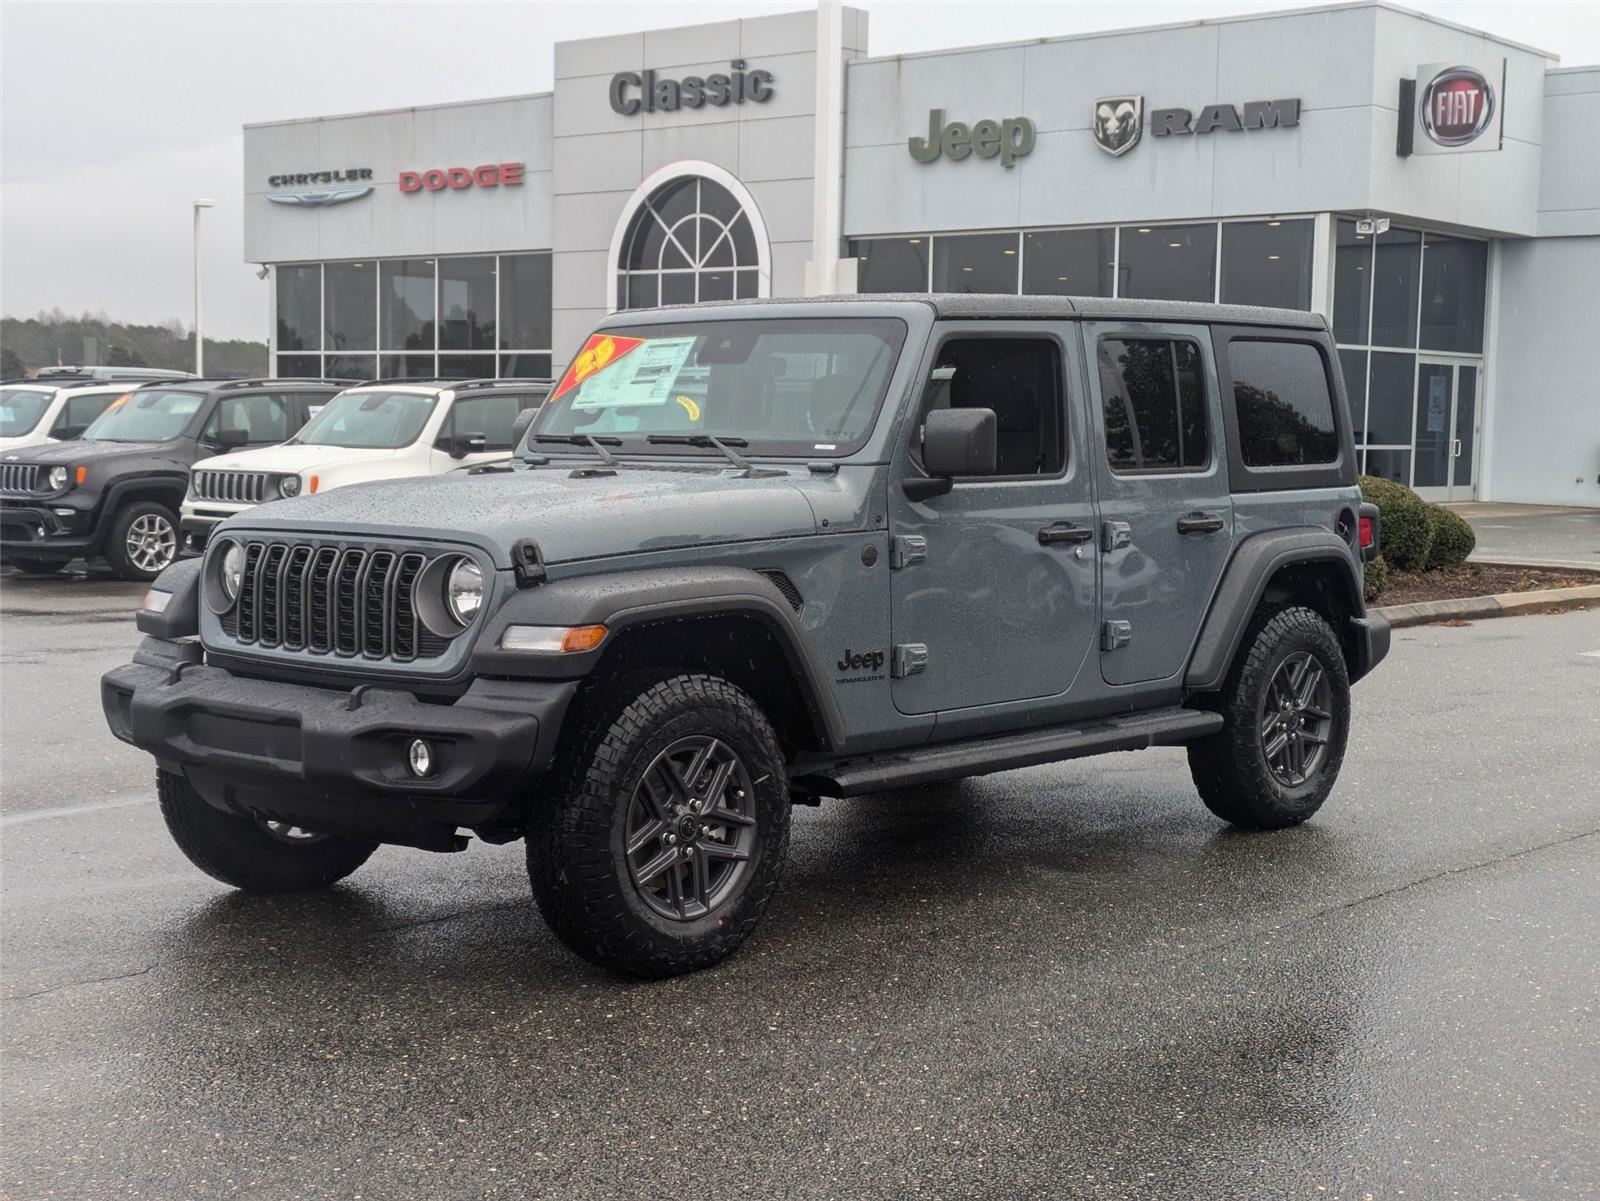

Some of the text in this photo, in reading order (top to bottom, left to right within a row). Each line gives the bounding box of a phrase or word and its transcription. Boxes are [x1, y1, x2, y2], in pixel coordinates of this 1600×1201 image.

[609, 59, 774, 115] Classic
[1150, 98, 1300, 136] RAM
[1436, 89, 1479, 126] FIAT
[908, 108, 1036, 168] Jeep
[268, 168, 373, 187] CHRYSLER
[399, 162, 525, 193] DODGE
[837, 649, 884, 671] Jeep
